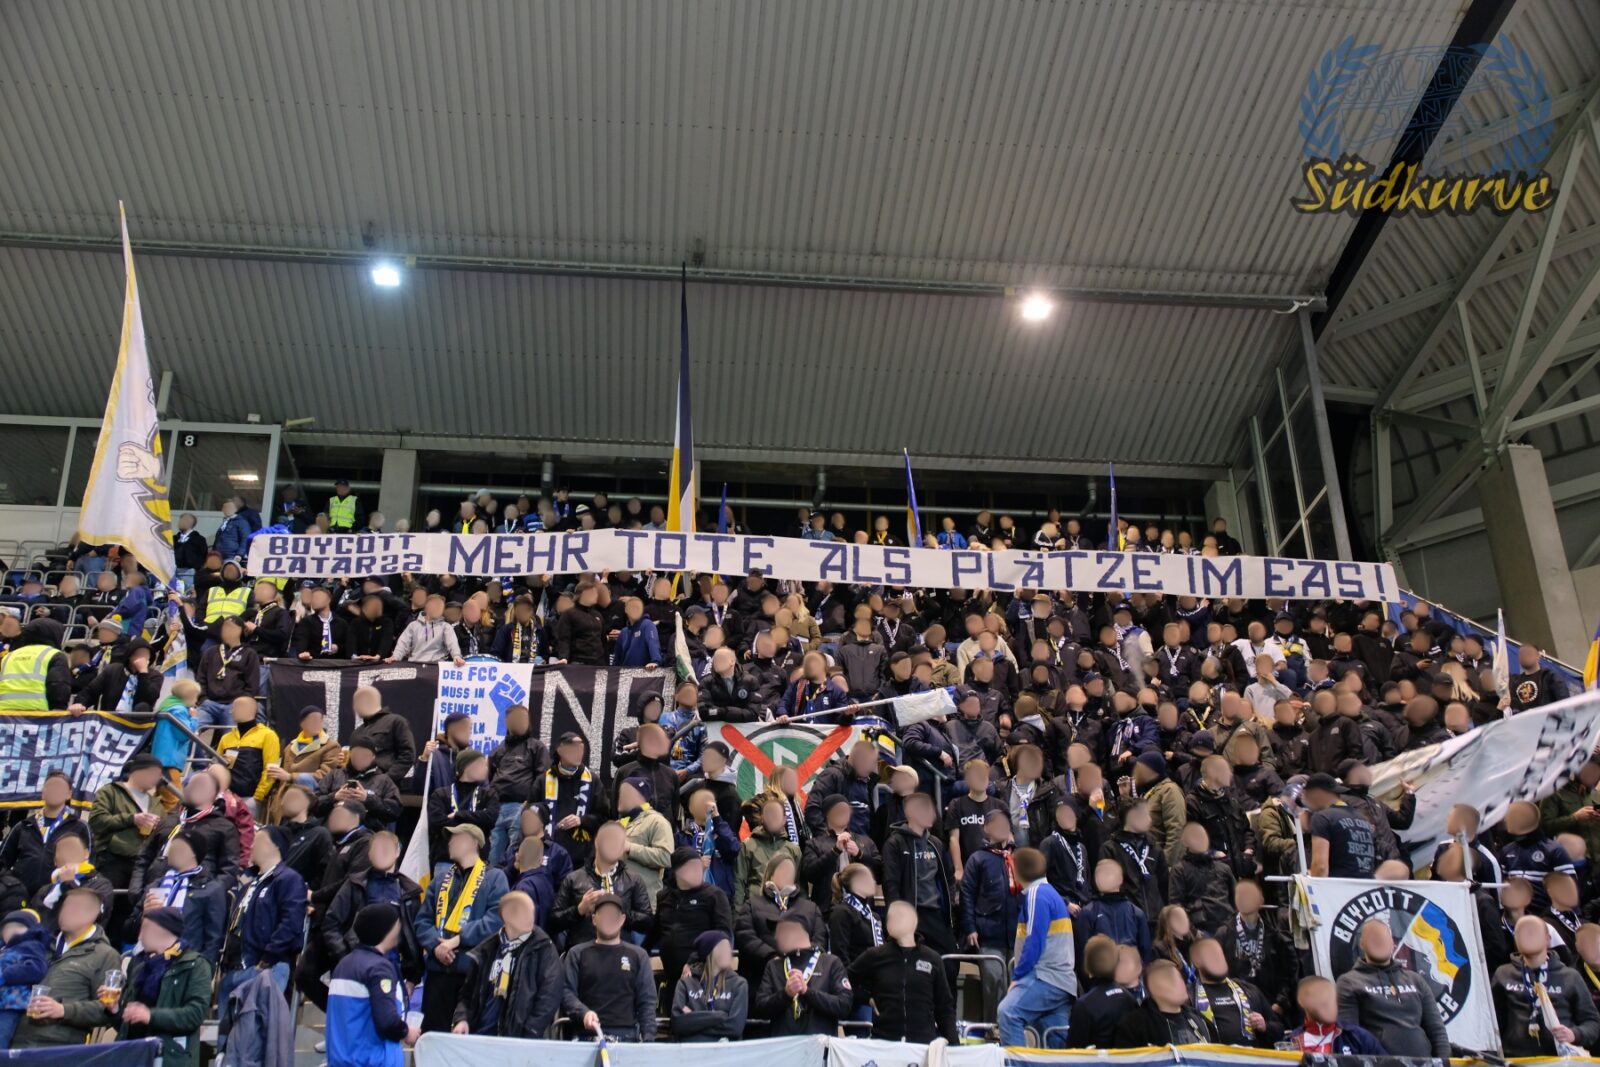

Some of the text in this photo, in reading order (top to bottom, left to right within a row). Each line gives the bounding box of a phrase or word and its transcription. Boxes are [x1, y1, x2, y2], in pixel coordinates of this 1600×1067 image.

[185, 435, 194, 446] 8
[269, 535, 416, 555] BOYCOTT
[262, 553, 423, 574] QATAR22
[448, 532, 589, 573] MEHR
[614, 530, 775, 575] TOTE
[810, 542, 912, 584] ALS
[952, 551, 1164, 590] PLÄTZE
[1187, 557, 1243, 596] IM
[442, 666, 498, 681] DER FCC
[441, 685, 485, 699] MUSS IN
[0, 720, 143, 764] EFUGEES
[961, 814, 985, 825] adid
[1334, 889, 1413, 944] BOYCOTT
